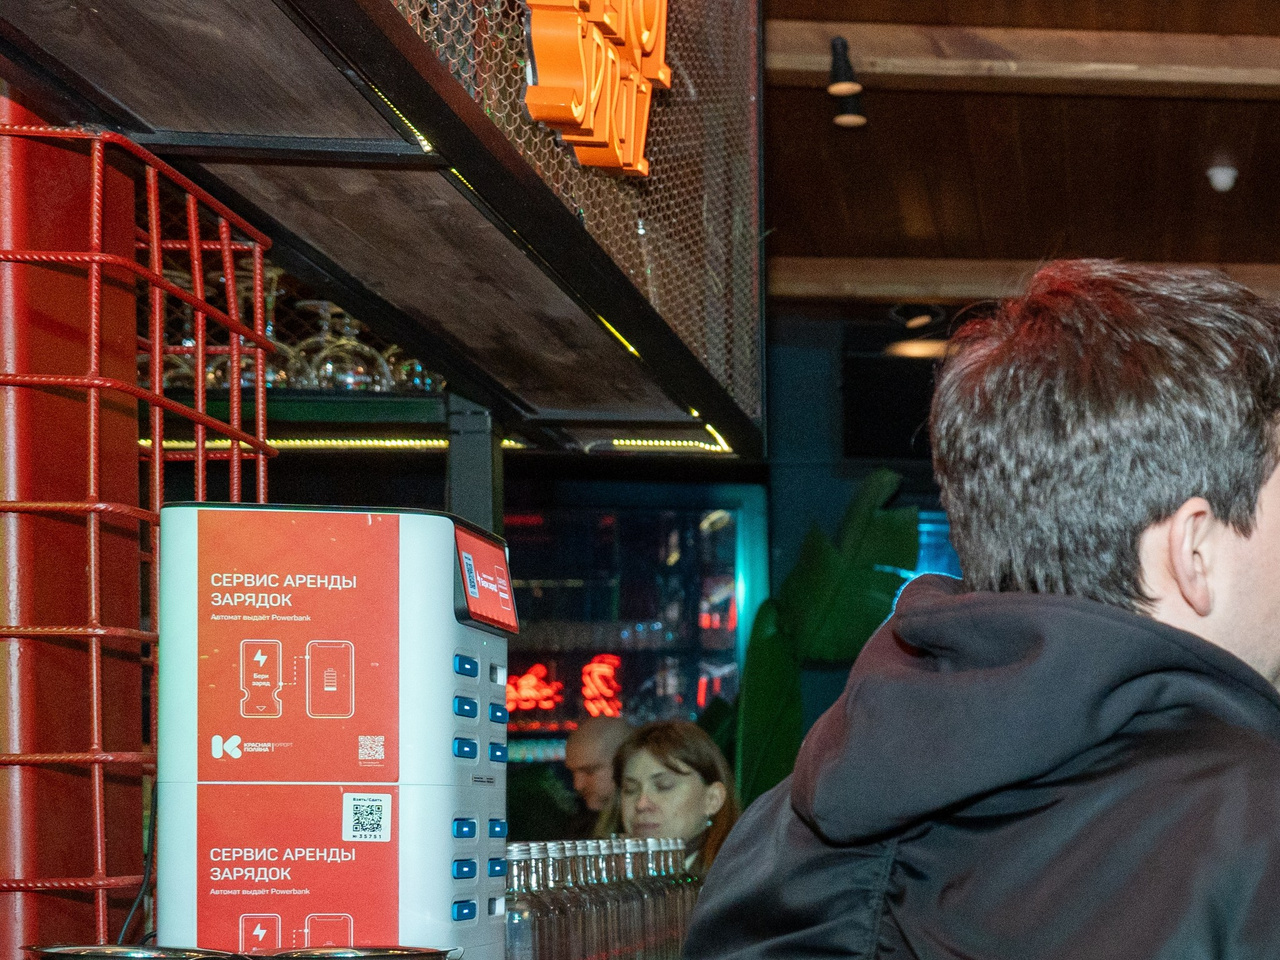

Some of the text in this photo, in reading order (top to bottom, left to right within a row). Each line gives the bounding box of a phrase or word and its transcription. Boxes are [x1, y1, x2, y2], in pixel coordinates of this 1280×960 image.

[211, 573, 357, 590] СЕРВИС АРЕНДЫ
[210, 593, 293, 608] ЗАРЯДОК
[210, 613, 241, 621] Автомат
[210, 848, 356, 863] СЕРВИС АРЕНДЫ
[210, 867, 292, 882] ЗАРЯДОК
[242, 888, 269, 896] выдаёт
